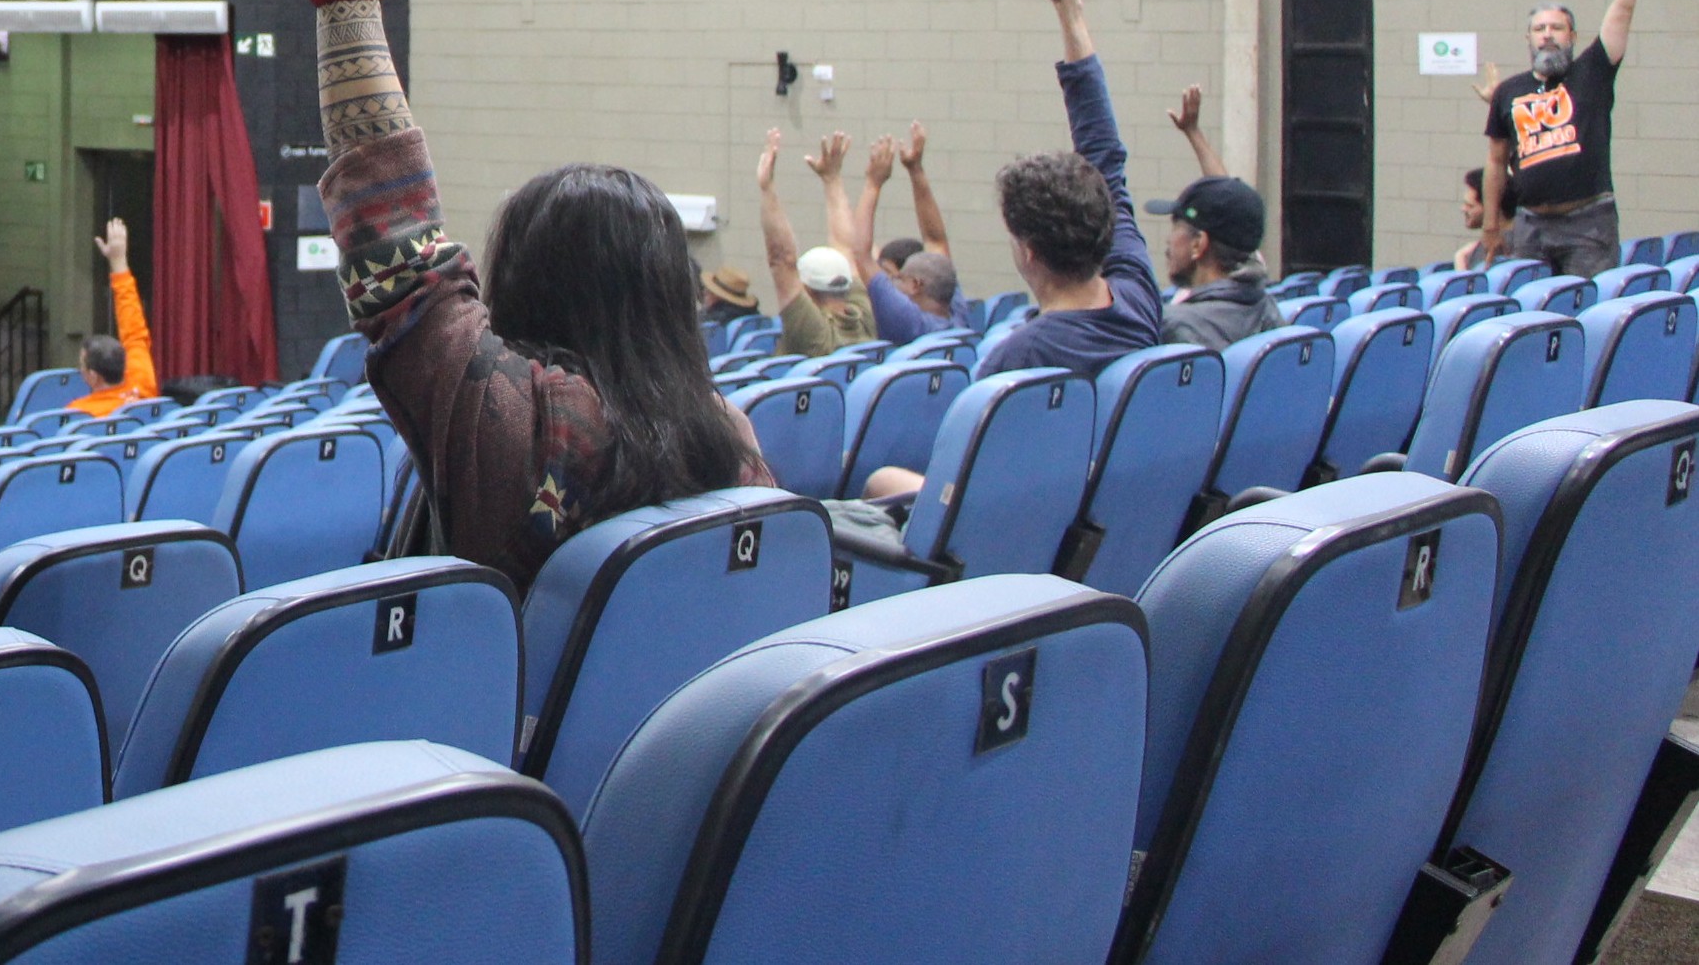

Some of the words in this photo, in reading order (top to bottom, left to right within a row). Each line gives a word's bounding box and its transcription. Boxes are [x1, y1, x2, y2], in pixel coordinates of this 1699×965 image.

[1668, 311, 1676, 331] O
[1302, 345, 1310, 362] N
[1550, 336, 1558, 356] P
[931, 375, 940, 390] N
[1182, 364, 1191, 383] O
[798, 394, 807, 411] O
[1052, 387, 1061, 405] P
[127, 445, 135, 457] N
[213, 446, 223, 460] O
[324, 441, 332, 457] P
[63, 466, 72, 481] P
[1675, 450, 1690, 490] Q
[737, 530, 755, 562] Q
[129, 555, 148, 582] Q
[1412, 545, 1431, 592] R
[387, 606, 405, 642] R
[996, 672, 1020, 731] S
[284, 887, 318, 964] T
